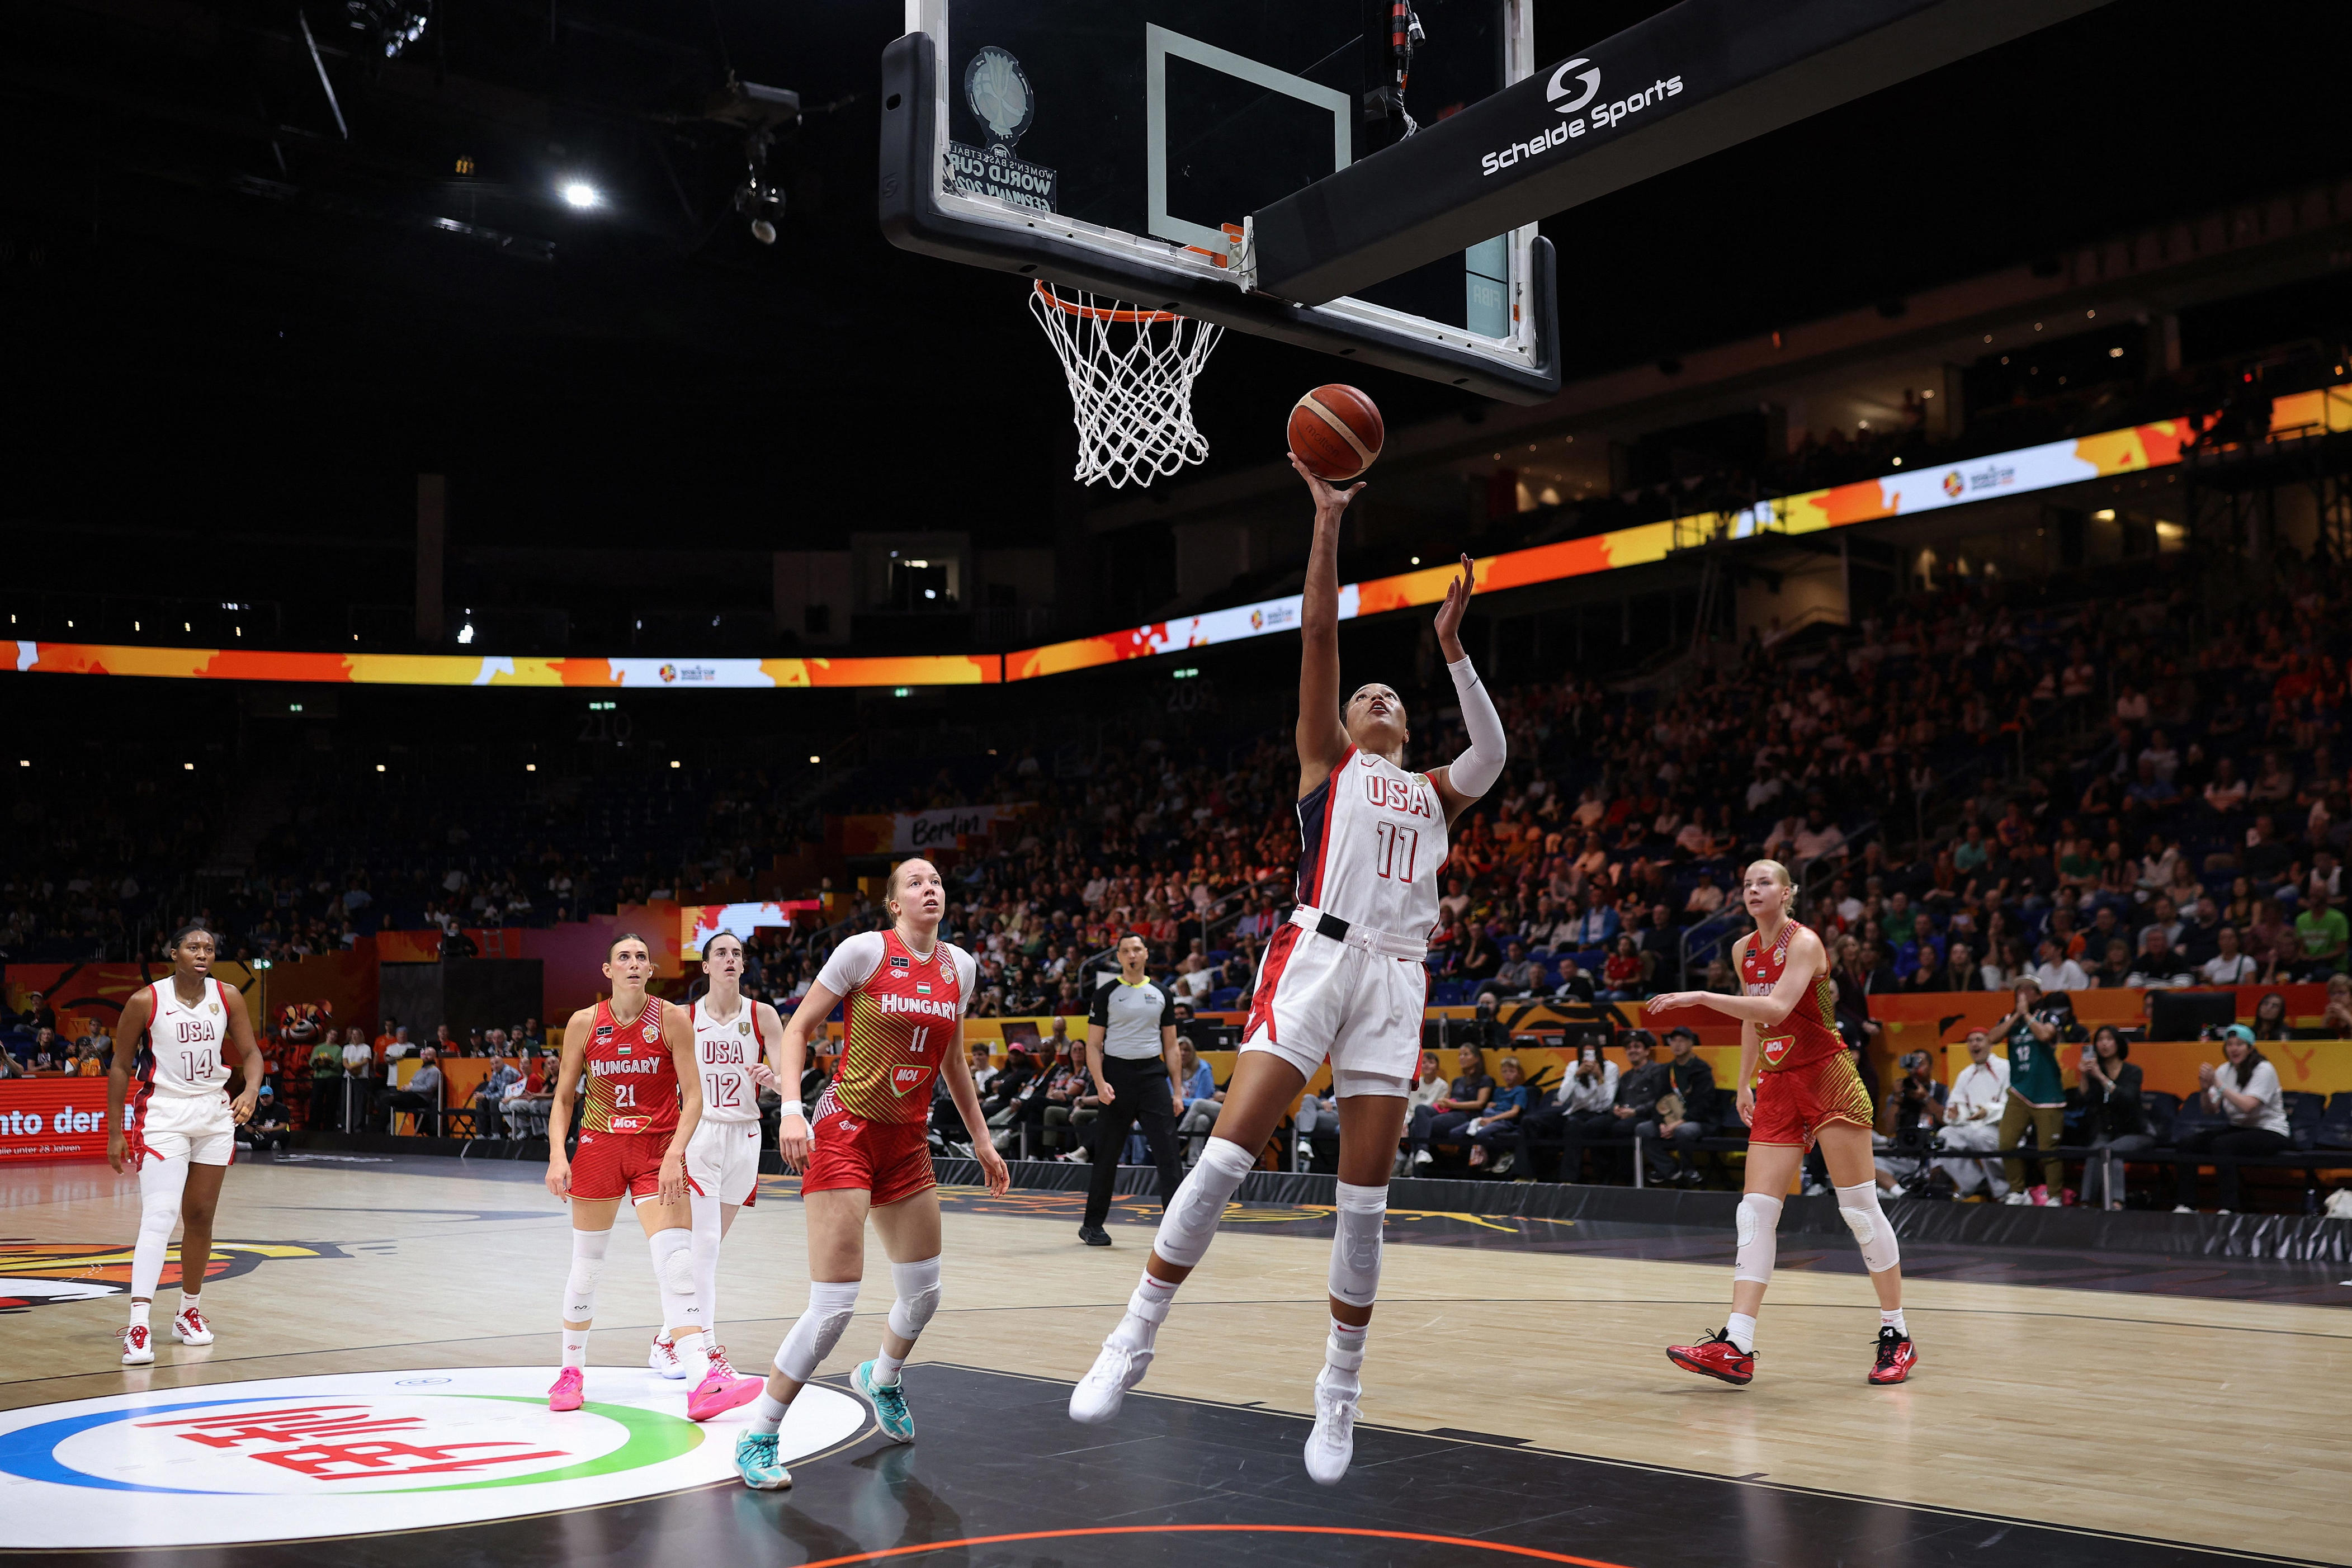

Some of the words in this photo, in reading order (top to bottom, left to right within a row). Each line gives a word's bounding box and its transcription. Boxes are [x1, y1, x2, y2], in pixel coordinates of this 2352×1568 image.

[1481, 119, 1586, 176] Schelde
[1591, 75, 1683, 128] Sports
[1306, 424, 1339, 458] molten
[1367, 775, 1430, 819] USA
[911, 814, 979, 846] Berlin
[1377, 821, 1418, 884] 11
[881, 993, 956, 1022] HUNGARY
[176, 1020, 215, 1043] USA
[909, 1026, 929, 1052] 11
[702, 1041, 744, 1064] USA
[1766, 1041, 1783, 1053] MOL
[181, 1049, 214, 1081] 14
[590, 1056, 660, 1078] HUNGARY
[895, 1069, 919, 1082] MOL
[615, 1084, 636, 1108] 21
[706, 1073, 741, 1108] 12
[54, 1105, 105, 1134] der
[613, 1118, 638, 1128] MOL
[13, 1146, 37, 1154] unter
[52, 1144, 81, 1153] Jahren
